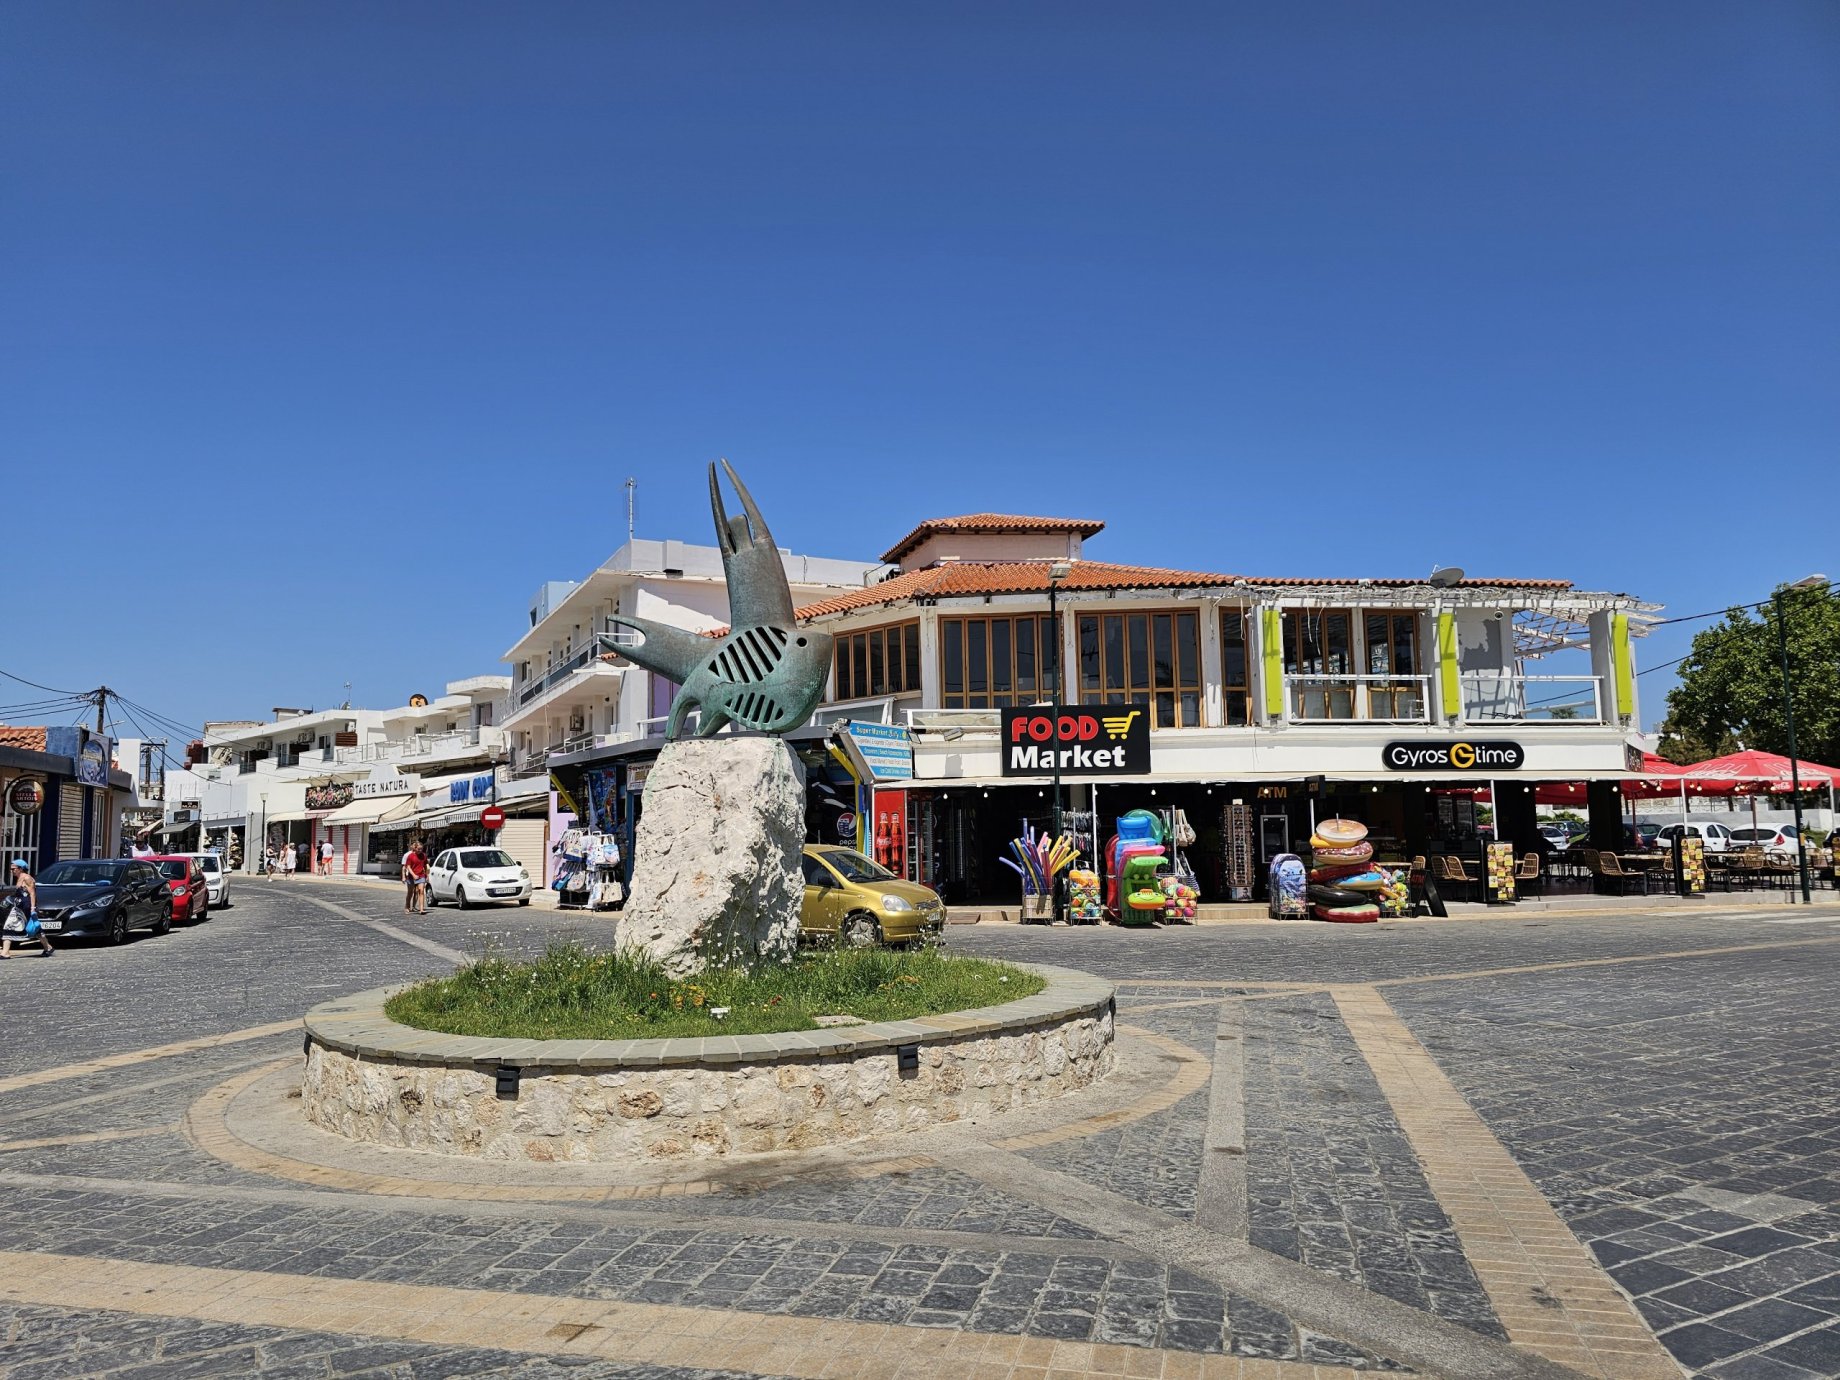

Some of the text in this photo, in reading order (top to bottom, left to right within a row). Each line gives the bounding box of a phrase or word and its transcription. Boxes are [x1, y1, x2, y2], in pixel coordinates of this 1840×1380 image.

[1011, 715, 1099, 742] FOOD
[1010, 744, 1126, 769] Market
[1391, 747, 1449, 767] Gyros
[1475, 745, 1518, 763] time
[355, 780, 409, 795] TASTE NATURA
[1257, 786, 1288, 799] ATM
[839, 839, 857, 847] peps
